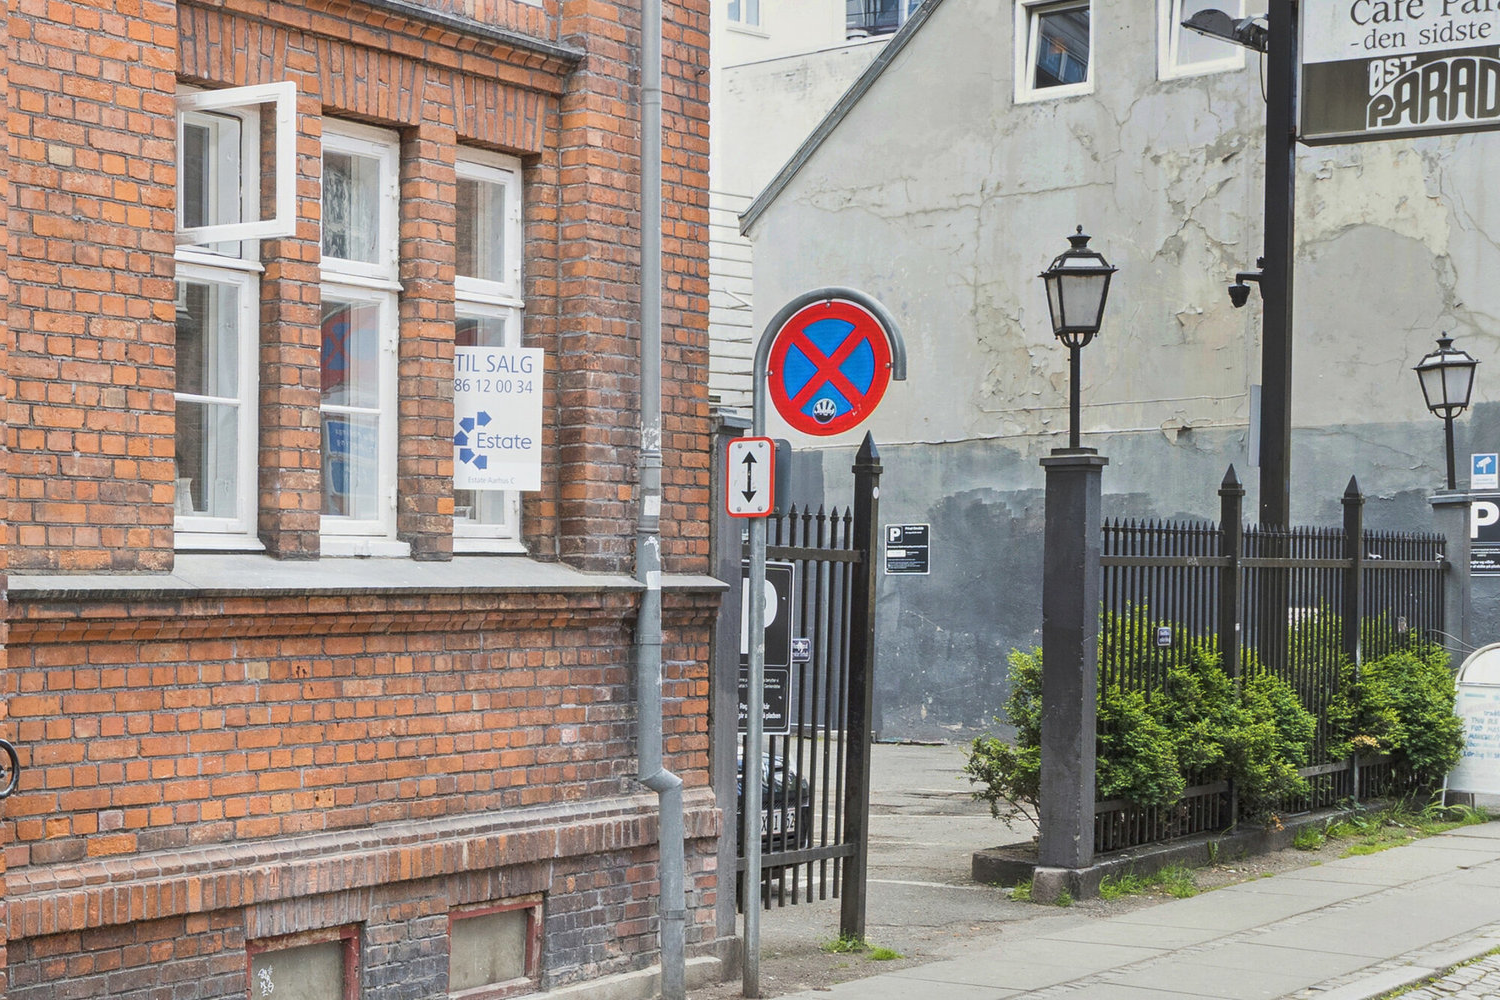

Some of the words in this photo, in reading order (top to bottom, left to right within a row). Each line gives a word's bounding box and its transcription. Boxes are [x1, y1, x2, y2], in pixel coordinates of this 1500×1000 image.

[1418, 20, 1492, 45] sidste
[455, 354, 480, 372] TIL
[486, 354, 533, 374] SALG
[454, 378, 471, 393] 86
[476, 379, 491, 393] 12
[495, 379, 512, 393] 00
[516, 380, 533, 394] 34
[476, 432, 532, 450] Estate
[1470, 501, 1500, 539] P
[890, 527, 901, 542] P
